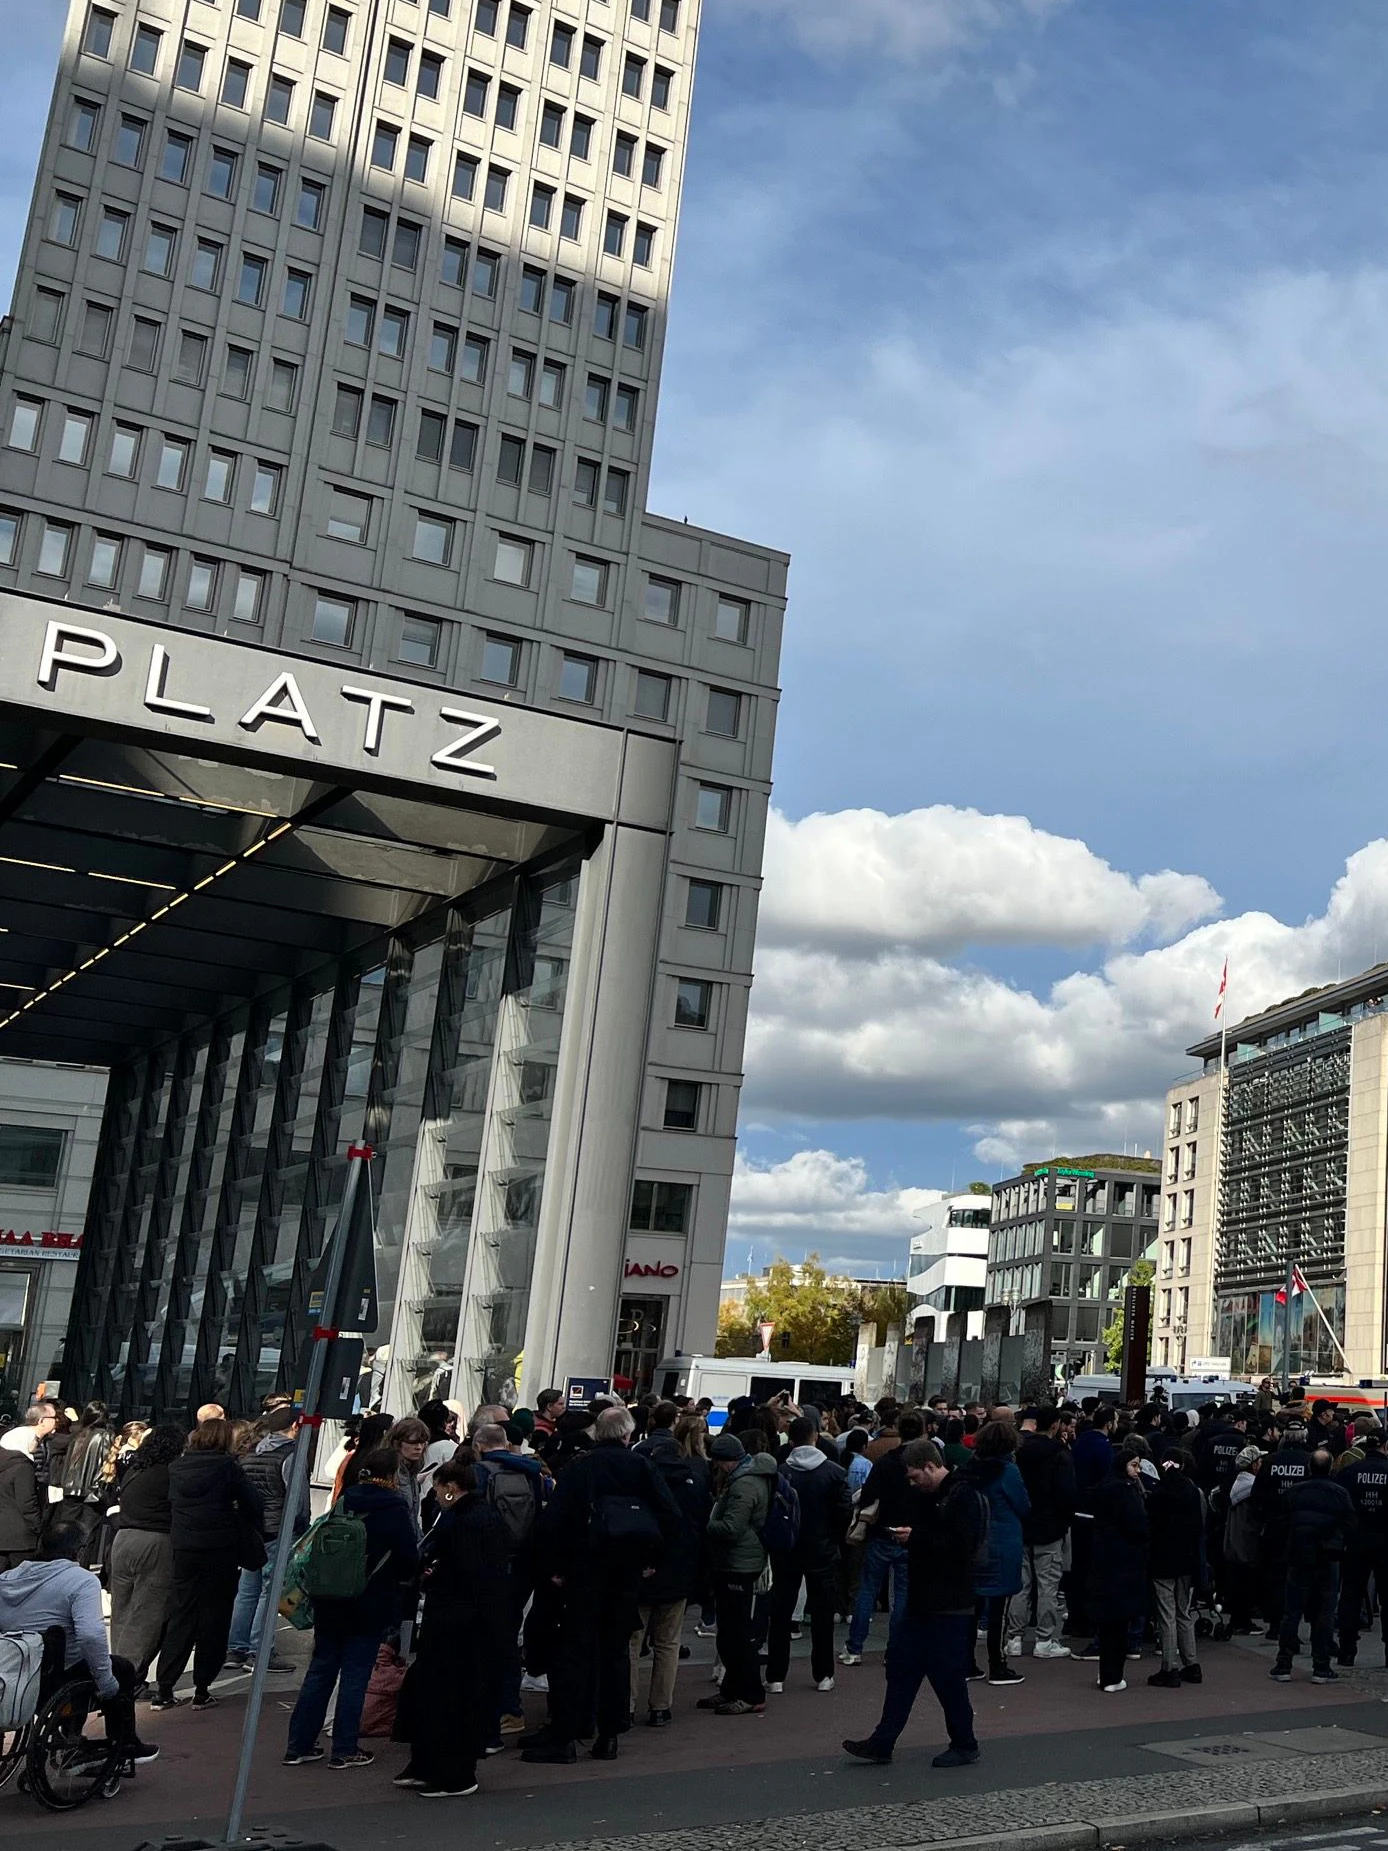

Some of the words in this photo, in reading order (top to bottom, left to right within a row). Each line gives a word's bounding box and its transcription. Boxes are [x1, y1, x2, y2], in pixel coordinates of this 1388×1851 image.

[37, 619, 500, 778] PLATZ
[1270, 1464, 1305, 1476] POLIZEI
[1357, 1472, 1388, 1485] POLIZEI
[1365, 1491, 1378, 1499] HH
